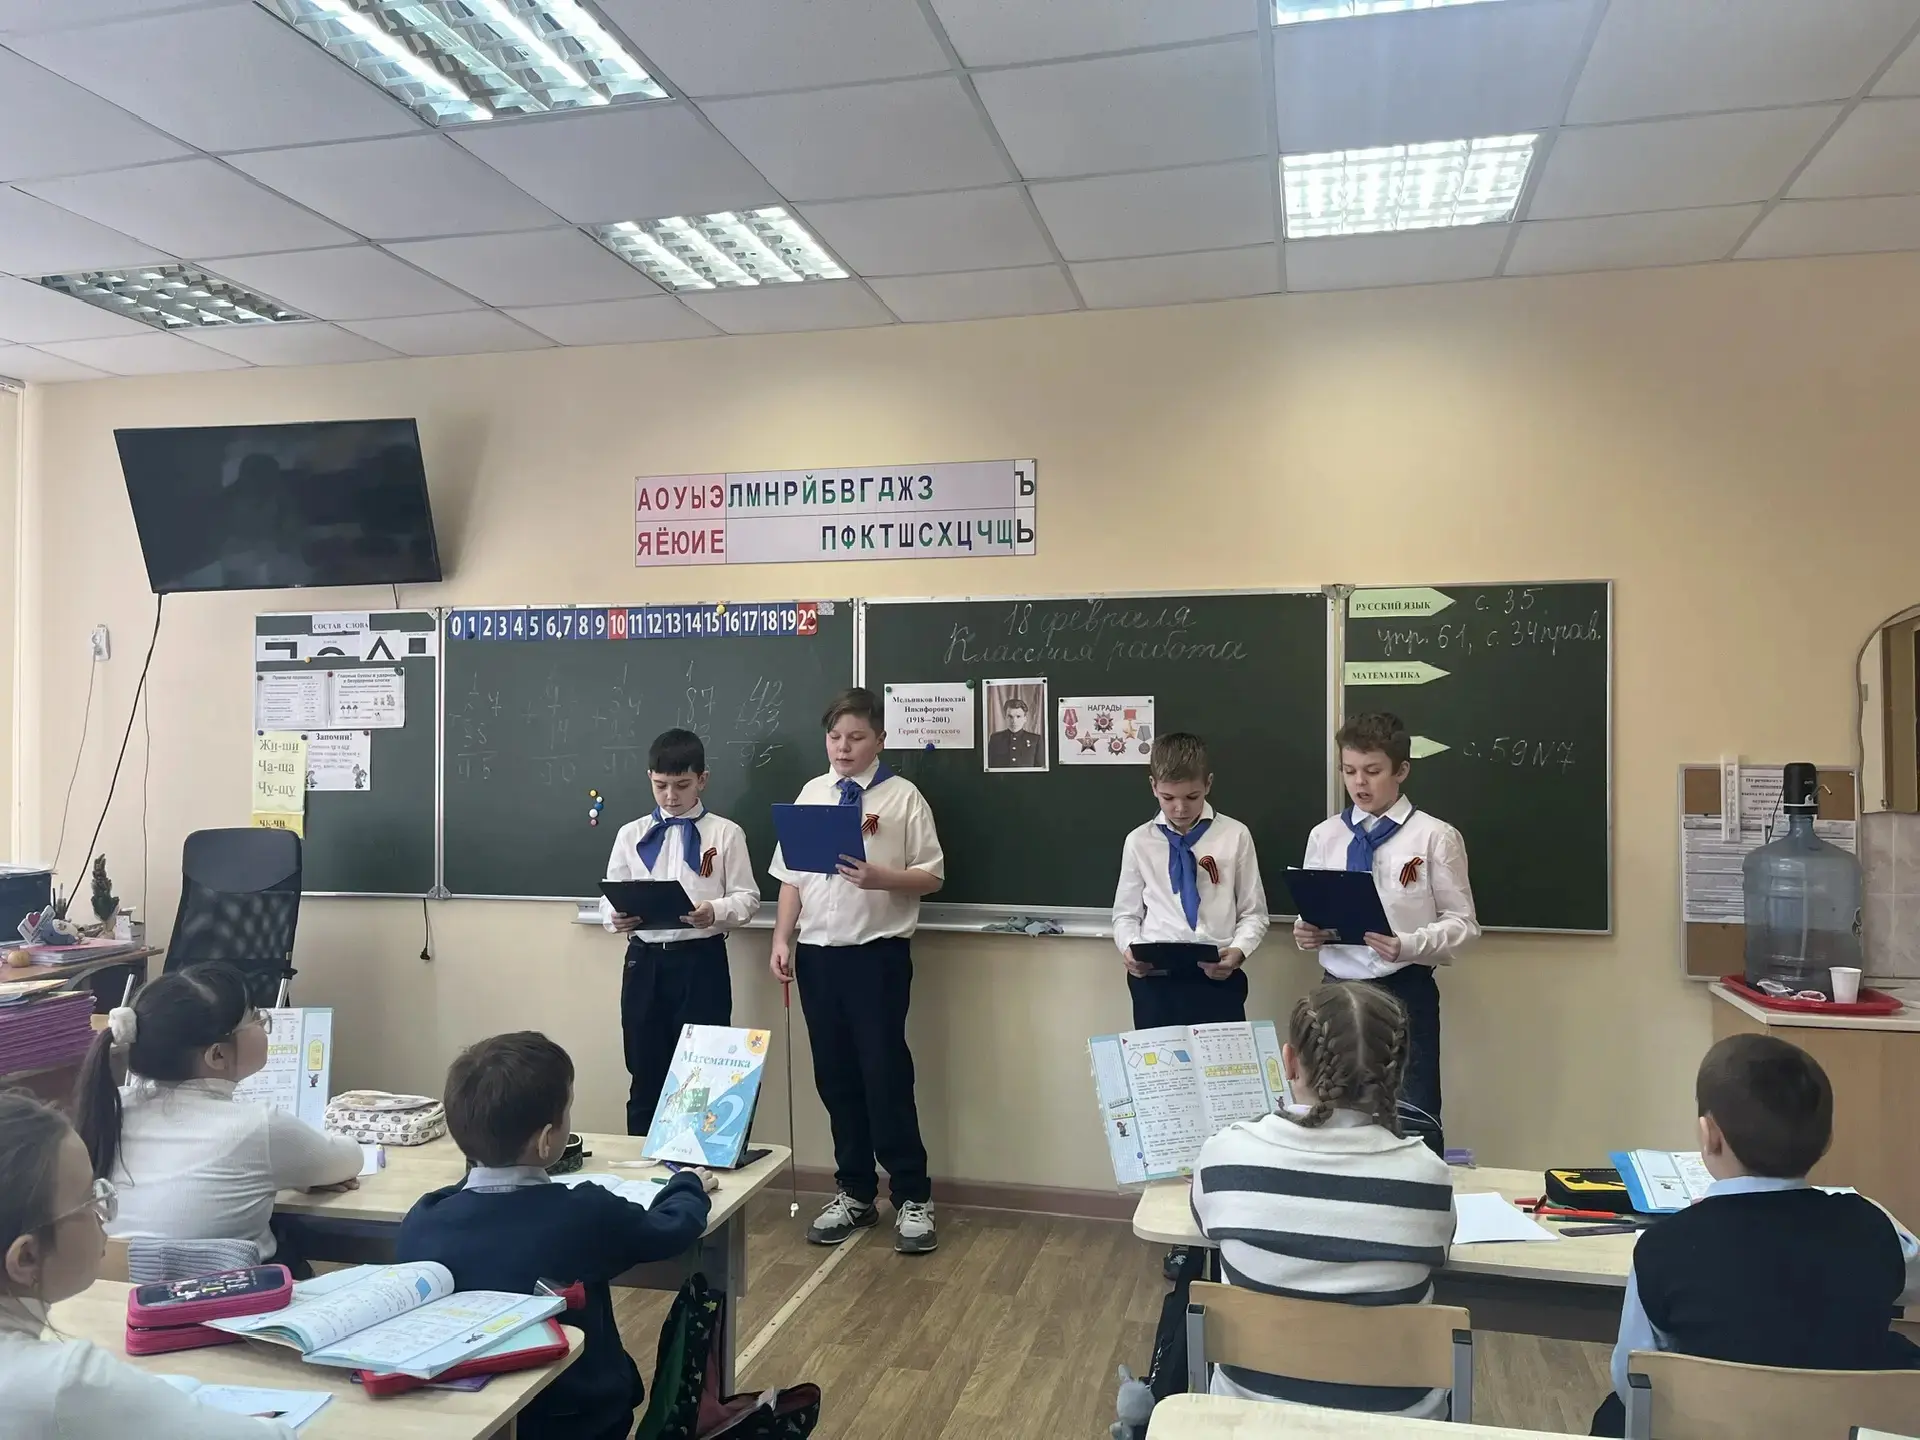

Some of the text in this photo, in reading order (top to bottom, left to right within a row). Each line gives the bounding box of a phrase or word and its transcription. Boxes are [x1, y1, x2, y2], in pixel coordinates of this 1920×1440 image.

[1356, 601, 1432, 611] РУССКИЙ ЯЗЫК
[452, 616, 461, 636] 0
[468, 616, 475, 632] 1
[483, 616, 492, 636] 2
[499, 616, 507, 636] 3
[514, 616, 523, 636] 4
[530, 616, 539, 636] 5
[547, 616, 556, 635] 6
[563, 615, 572, 635] 7
[579, 615, 589, 635] 8
[595, 615, 605, 635] 9
[610, 615, 625, 634] 10
[629, 613, 642, 634] 11
[647, 613, 662, 633] 12
[666, 613, 681, 633] 13
[685, 612, 701, 633] 14
[704, 612, 719, 632] 15
[723, 611, 739, 632] 16
[742, 611, 757, 631] 17
[761, 610, 777, 631] 18
[780, 610, 796, 630] 19
[1004, 603, 1033, 636] 18
[1106, 630, 1249, 671] работа
[1352, 671, 1420, 680] МАТЕМАТИКА
[1087, 704, 1122, 712] НАГРАДЫ
[316, 732, 353, 740] Запомни!
[898, 727, 919, 735] Герой
[259, 739, 299, 752] Жи-ши
[258, 760, 295, 774] Ча-ща
[258, 781, 296, 796] Чу-щу
[680, 1050, 752, 1069] Математика
[704, 1094, 745, 1146] 2
